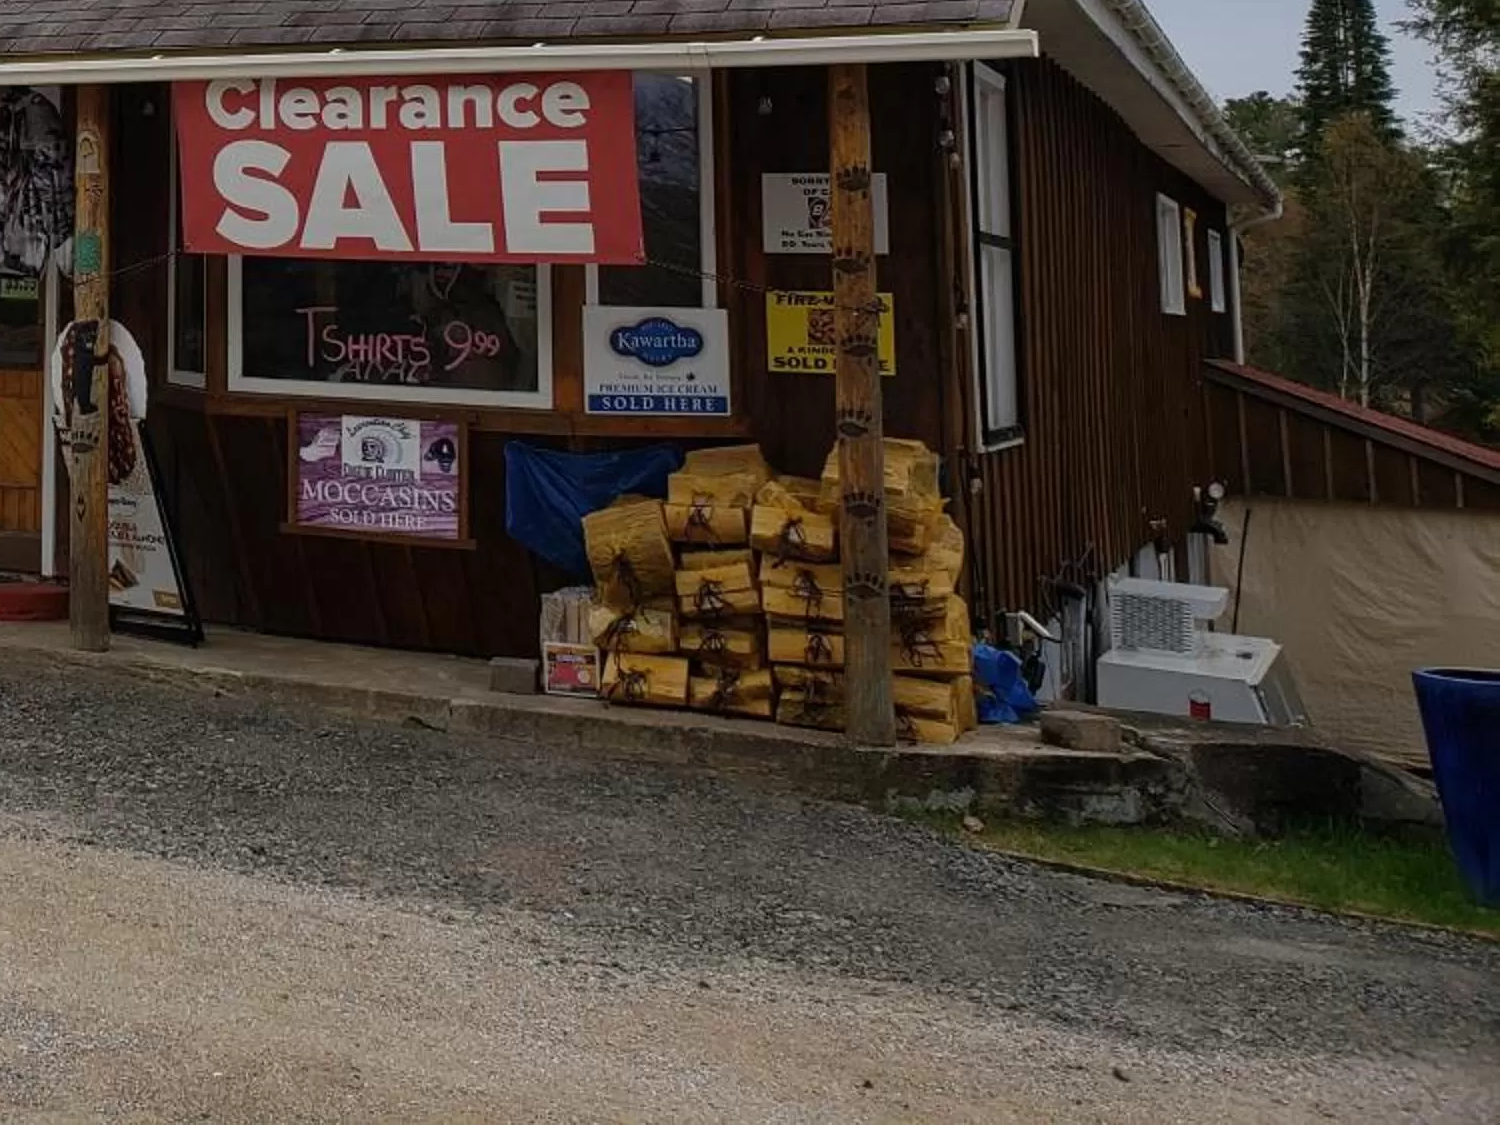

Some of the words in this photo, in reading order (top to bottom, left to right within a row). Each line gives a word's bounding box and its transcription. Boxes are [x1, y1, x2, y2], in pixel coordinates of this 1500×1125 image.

[204, 79, 591, 131] Clearance
[212, 139, 596, 254] SALE
[616, 331, 697, 350] Kawartha
[773, 357, 827, 369] SOLD
[677, 384, 717, 394] CREAM
[601, 396, 655, 411] SOLD
[663, 397, 717, 412] HERE
[300, 478, 456, 512] MOCCASINS
[329, 507, 376, 525] SOLD
[380, 512, 427, 529] HERE
